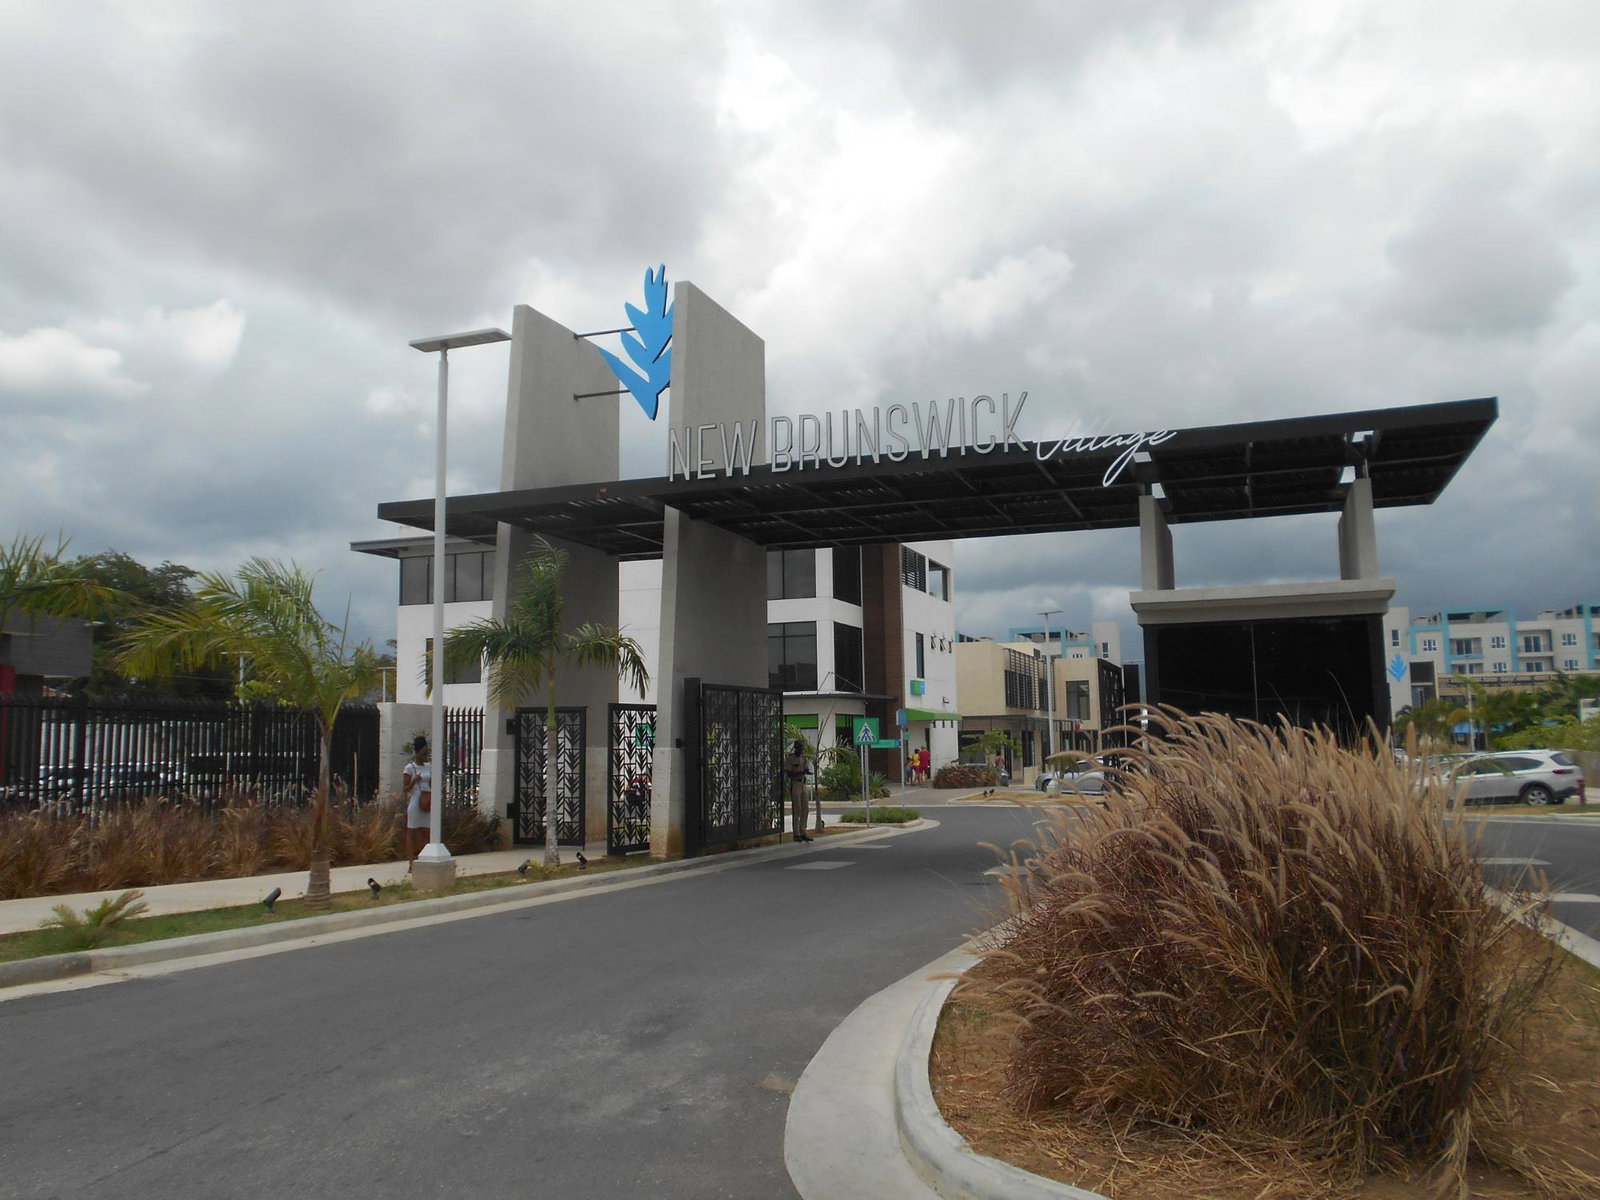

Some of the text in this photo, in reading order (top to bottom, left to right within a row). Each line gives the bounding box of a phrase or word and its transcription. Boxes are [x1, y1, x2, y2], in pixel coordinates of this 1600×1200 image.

[669, 391, 1177, 487] NEW BRUNSWICK Village
